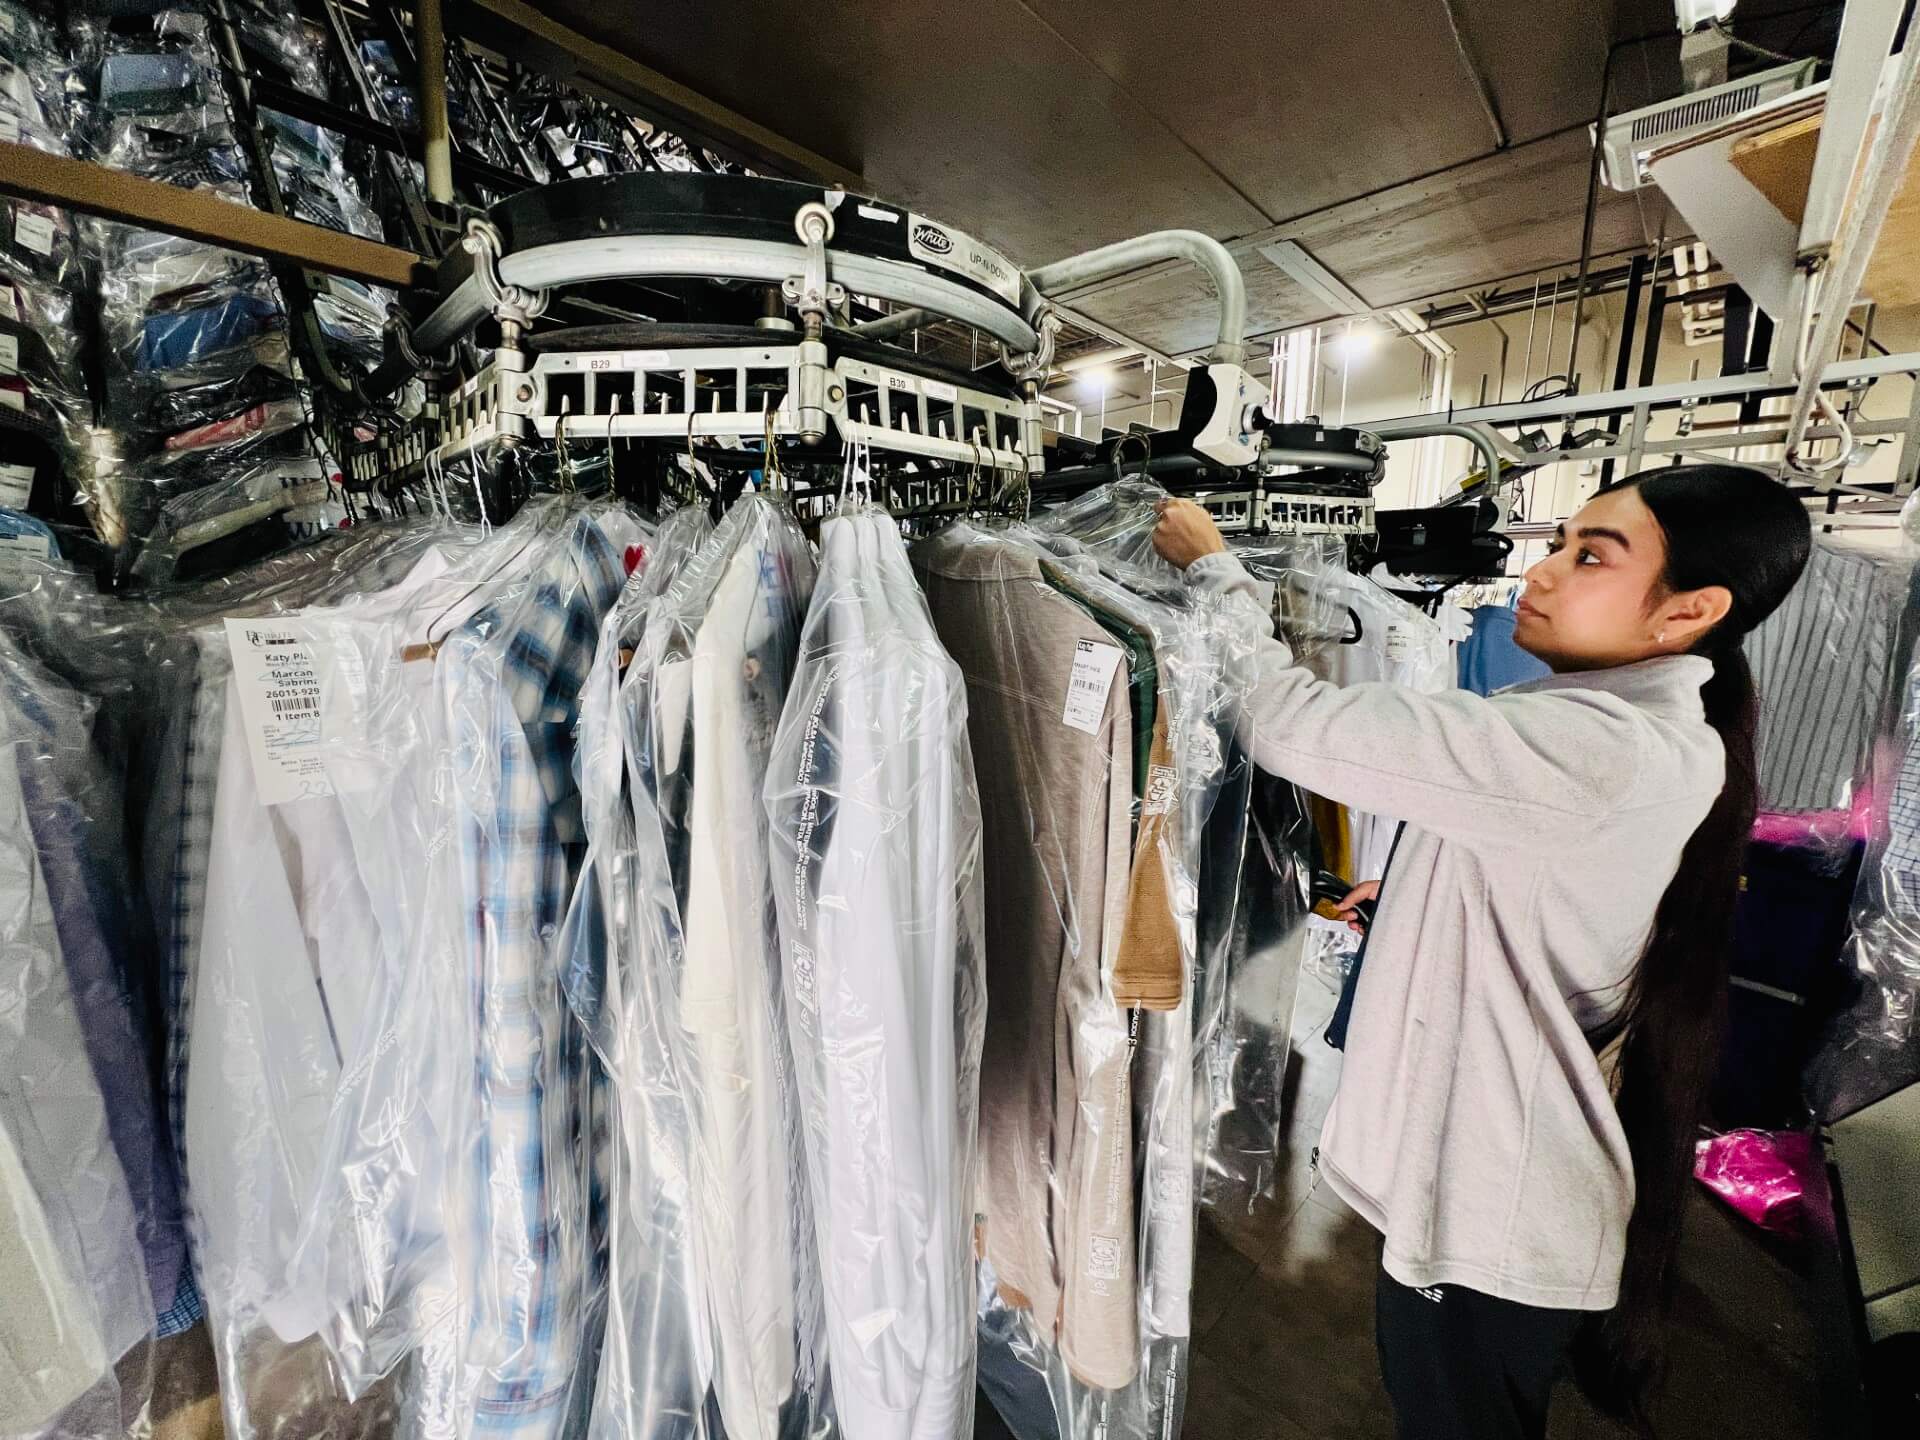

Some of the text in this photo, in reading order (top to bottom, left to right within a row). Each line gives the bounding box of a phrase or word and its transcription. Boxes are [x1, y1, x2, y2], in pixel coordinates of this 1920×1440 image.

[915, 226, 949, 250] White
[591, 360, 610, 369] B29
[890, 377, 906, 389] B30
[265, 653, 289, 663] Katy
[272, 670, 313, 679] Marcan
[266, 687, 320, 698] 26015-929
[285, 711, 311, 720] Item
